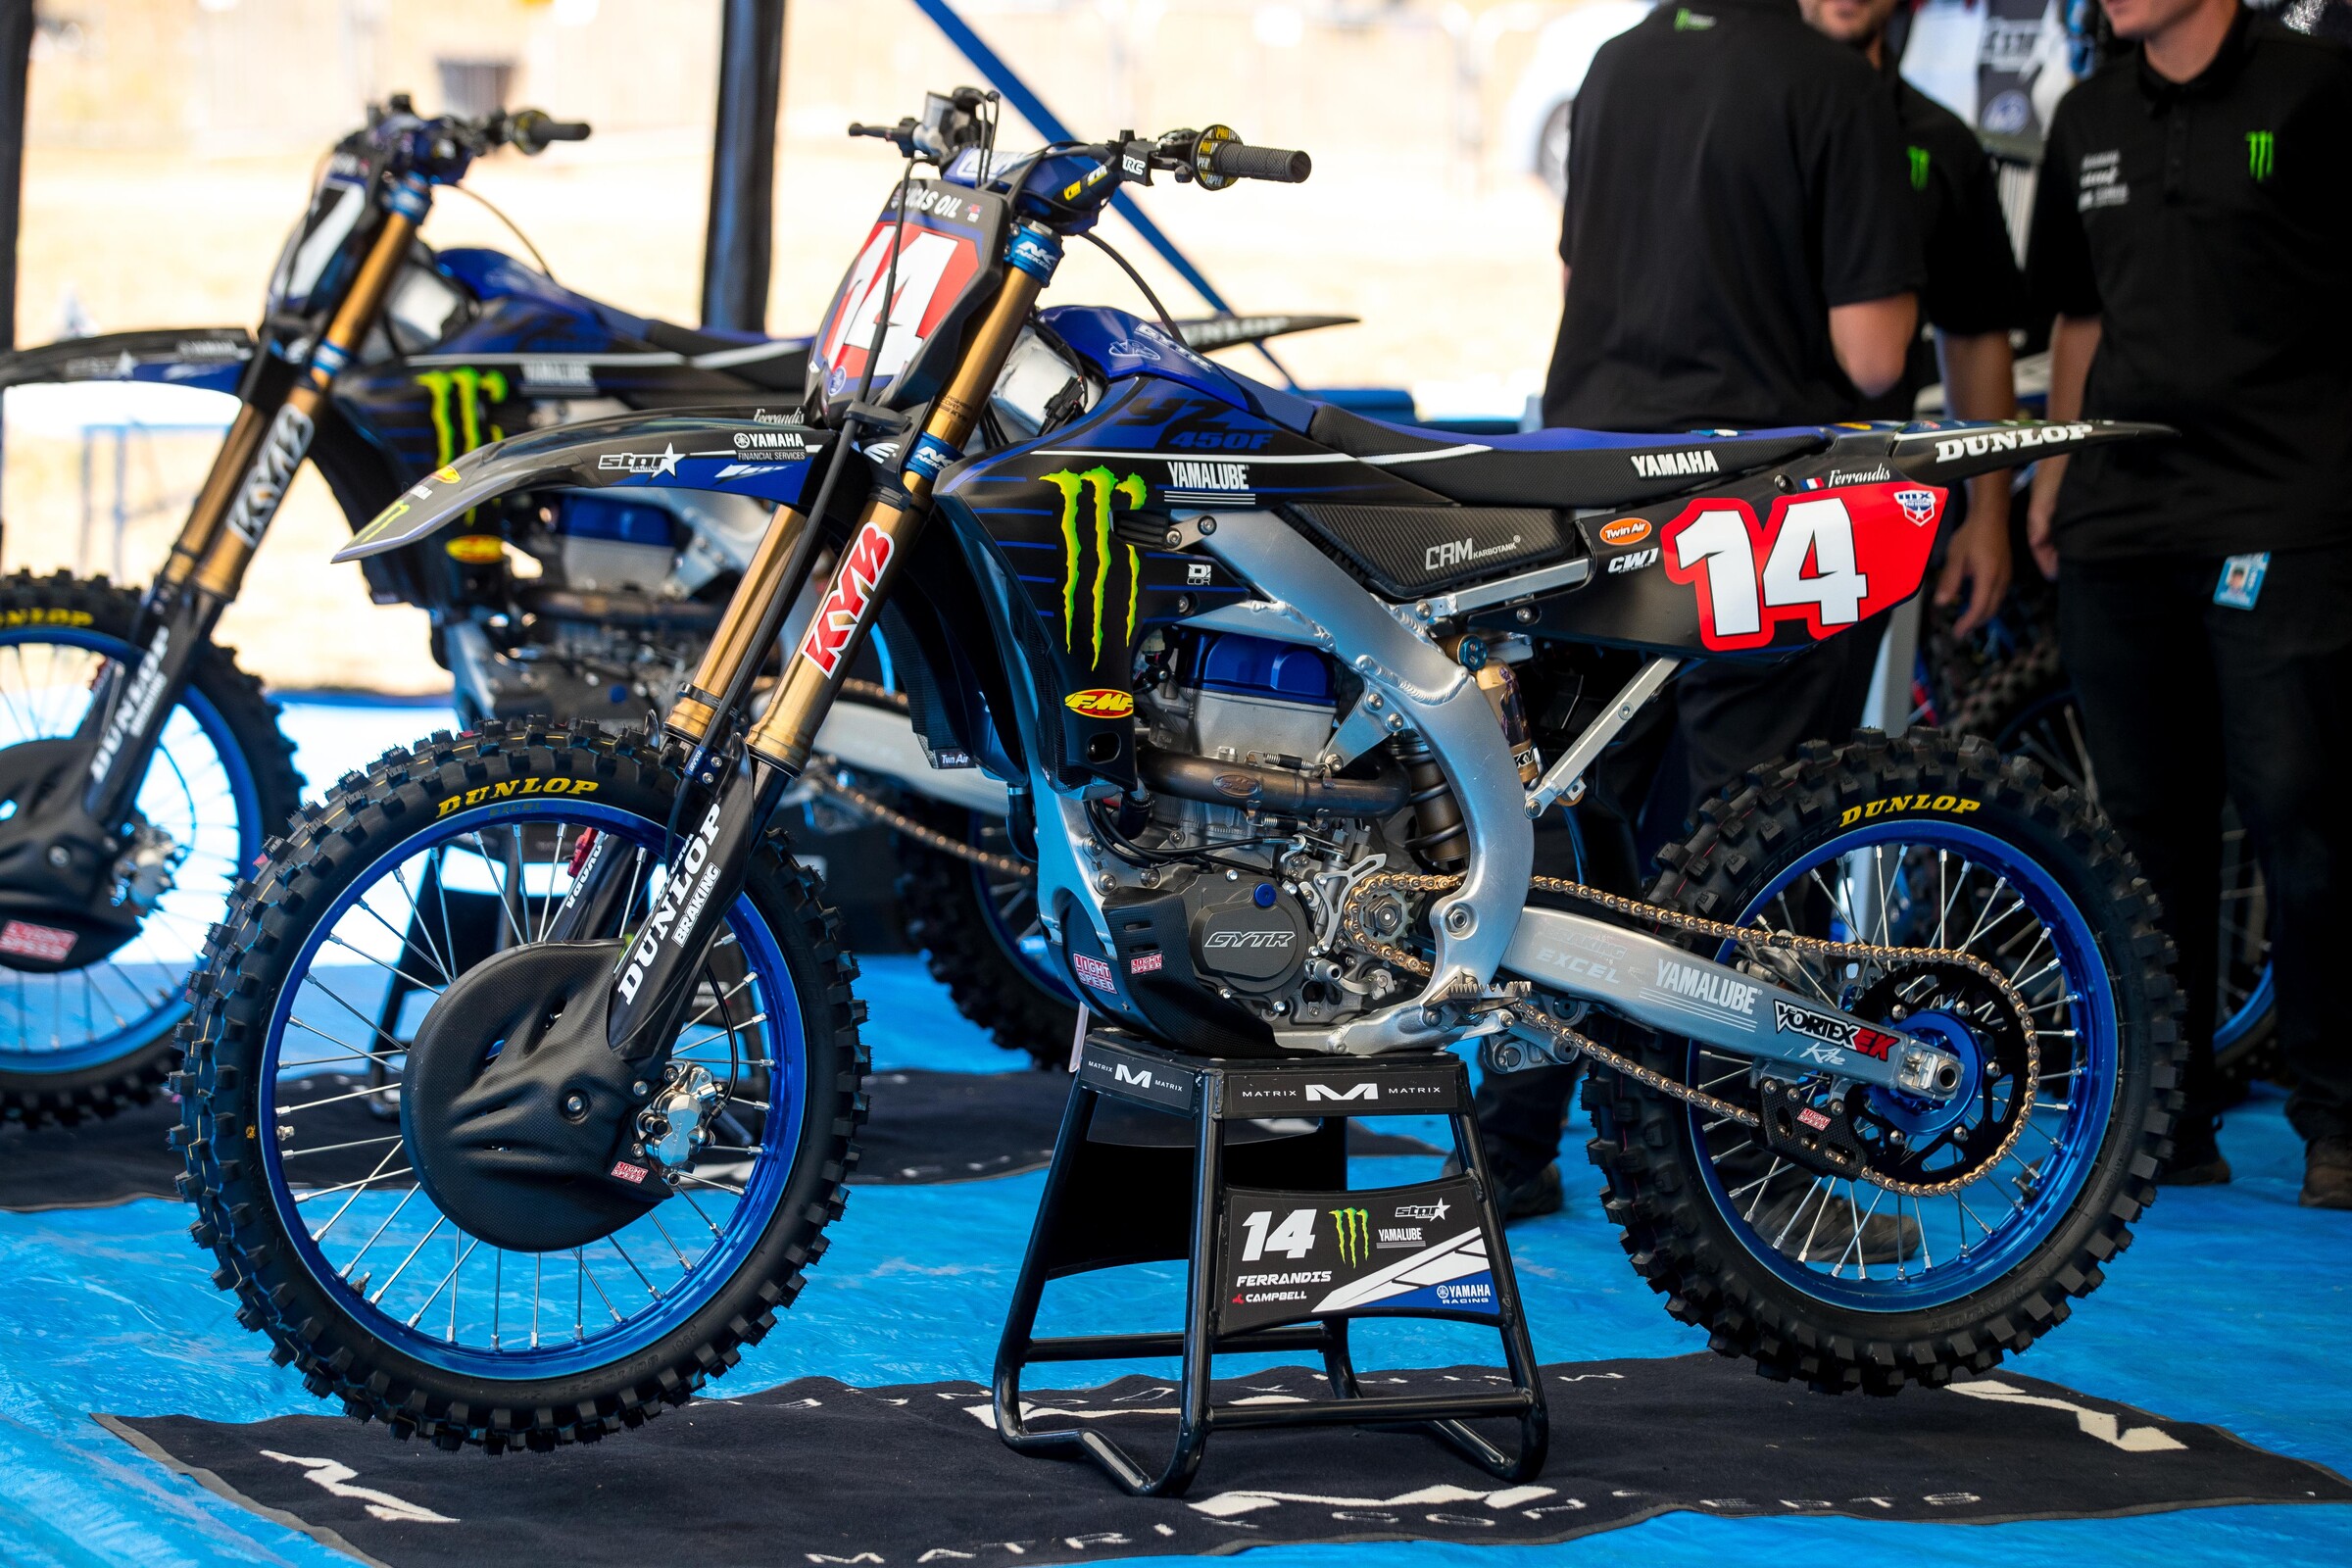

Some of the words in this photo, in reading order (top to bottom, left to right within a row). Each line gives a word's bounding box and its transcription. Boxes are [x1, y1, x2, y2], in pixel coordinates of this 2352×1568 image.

[934, 195, 962, 219] OIL
[821, 224, 959, 380] 14
[754, 407, 806, 424] Ferrandis
[750, 433, 805, 448] YAMAHA
[1169, 431, 1274, 450] 450F
[1936, 424, 2093, 463] DUNLOP
[738, 451, 773, 462] FINANCIAL
[774, 451, 806, 461] SERVICES
[1630, 450, 1720, 478] YAMAHA
[1167, 462, 1250, 490] YAMALUBE
[1828, 463, 1891, 488] Ferrandis
[1605, 526, 1631, 539] Twin
[1631, 522, 1647, 533] Air
[1425, 537, 1473, 570] CRM
[1473, 542, 1517, 560] KARBOTANK
[1674, 498, 1867, 637] 14
[801, 521, 895, 680] KYB
[1064, 693, 1134, 711] FMF
[941, 754, 956, 764] Twin
[436, 777, 600, 819] DUNLOP
[1838, 794, 1982, 828] DUNLOP
[616, 804, 723, 1005] DUNLOP
[672, 863, 721, 948] BRAKING
[1203, 931, 1297, 948] GYTR
[1074, 955, 1111, 979] LIGHT
[1131, 955, 1161, 967] LIGHT
[1131, 961, 1161, 973] SPEED
[1536, 947, 1621, 985] EXCEL
[1078, 971, 1116, 993] SPEED
[1657, 957, 1759, 1015] YAMALUBE
[1088, 1060, 1113, 1073] MATRIX
[1154, 1079, 1184, 1093] MATRIX
[1242, 1089, 1298, 1099] MATRIX
[1388, 1086, 1442, 1096] MATRIX
[612, 1169, 643, 1183] SPEED
[616, 1161, 647, 1176] LIGHT
[1242, 1208, 1317, 1262] 14
[1378, 1227, 1423, 1242] YAMALUBE
[1236, 1271, 1333, 1288] FERRANDIS
[1448, 1284, 1492, 1298] YAMAHA
[1246, 1291, 1307, 1303] CAMPBELL
